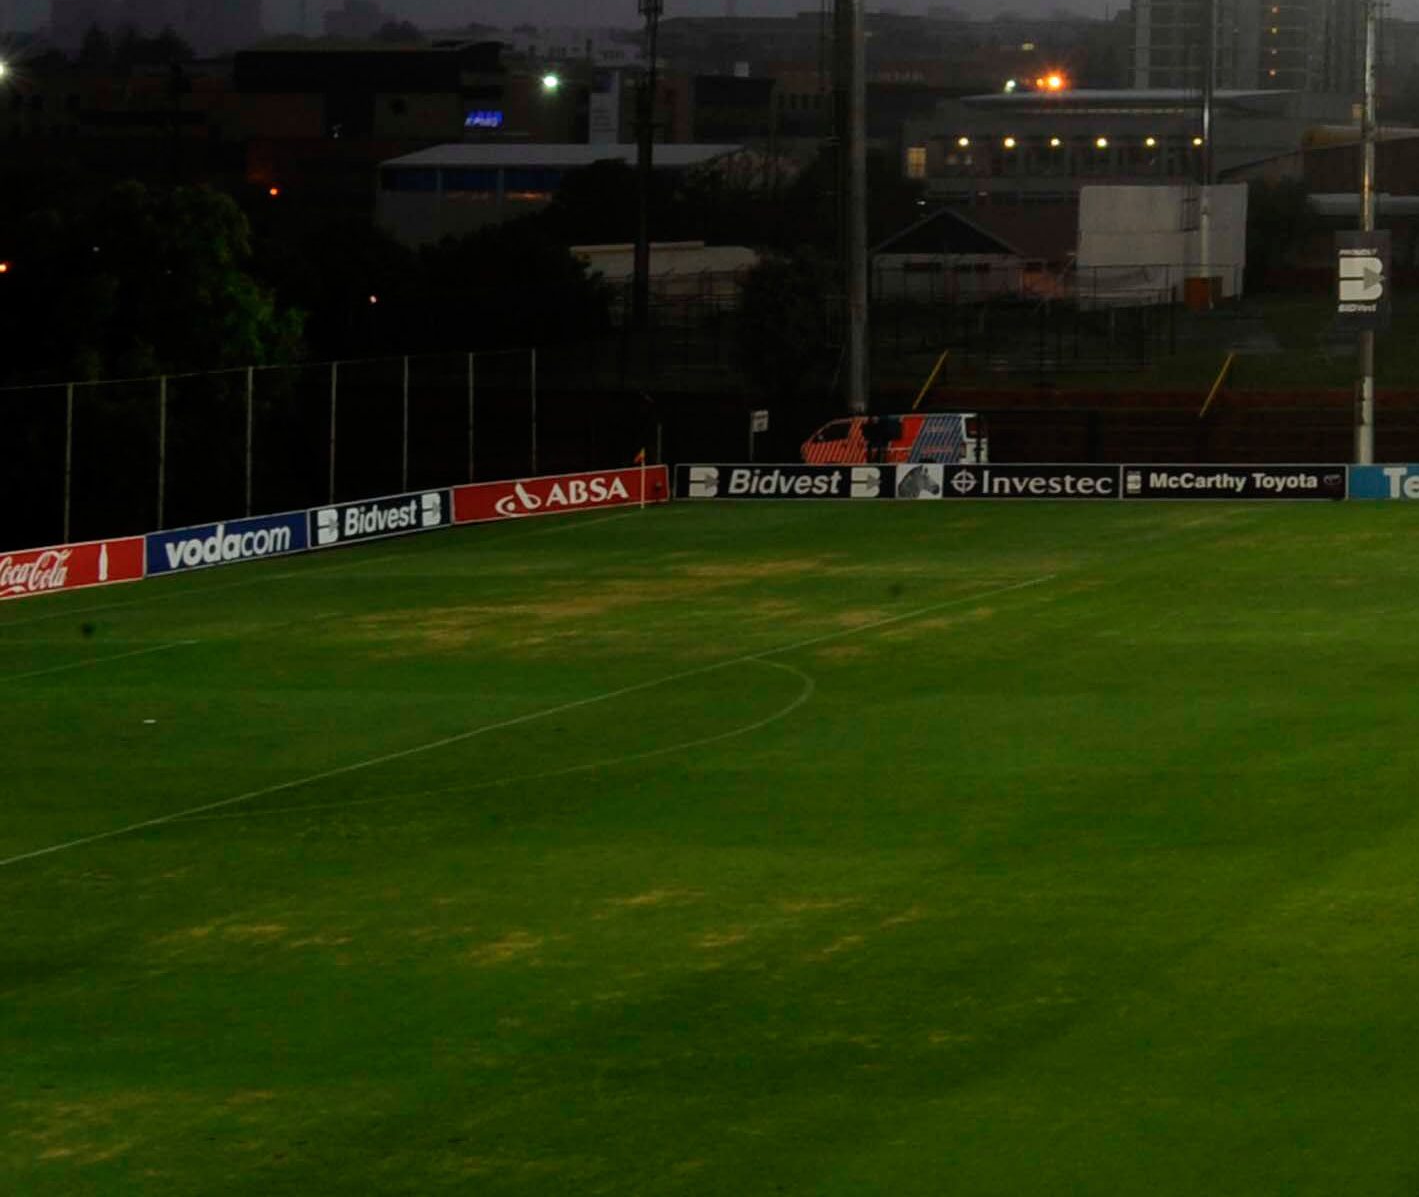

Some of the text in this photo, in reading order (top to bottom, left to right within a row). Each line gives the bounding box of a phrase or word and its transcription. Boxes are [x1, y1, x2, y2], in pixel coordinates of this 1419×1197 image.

[545, 476, 630, 507] ABSA
[727, 468, 843, 495] Bidvest
[982, 470, 1113, 495] Investec
[1149, 472, 1319, 492] McCarthy Toyota
[344, 500, 417, 537] Bidvest
[165, 523, 291, 569] vodacom
